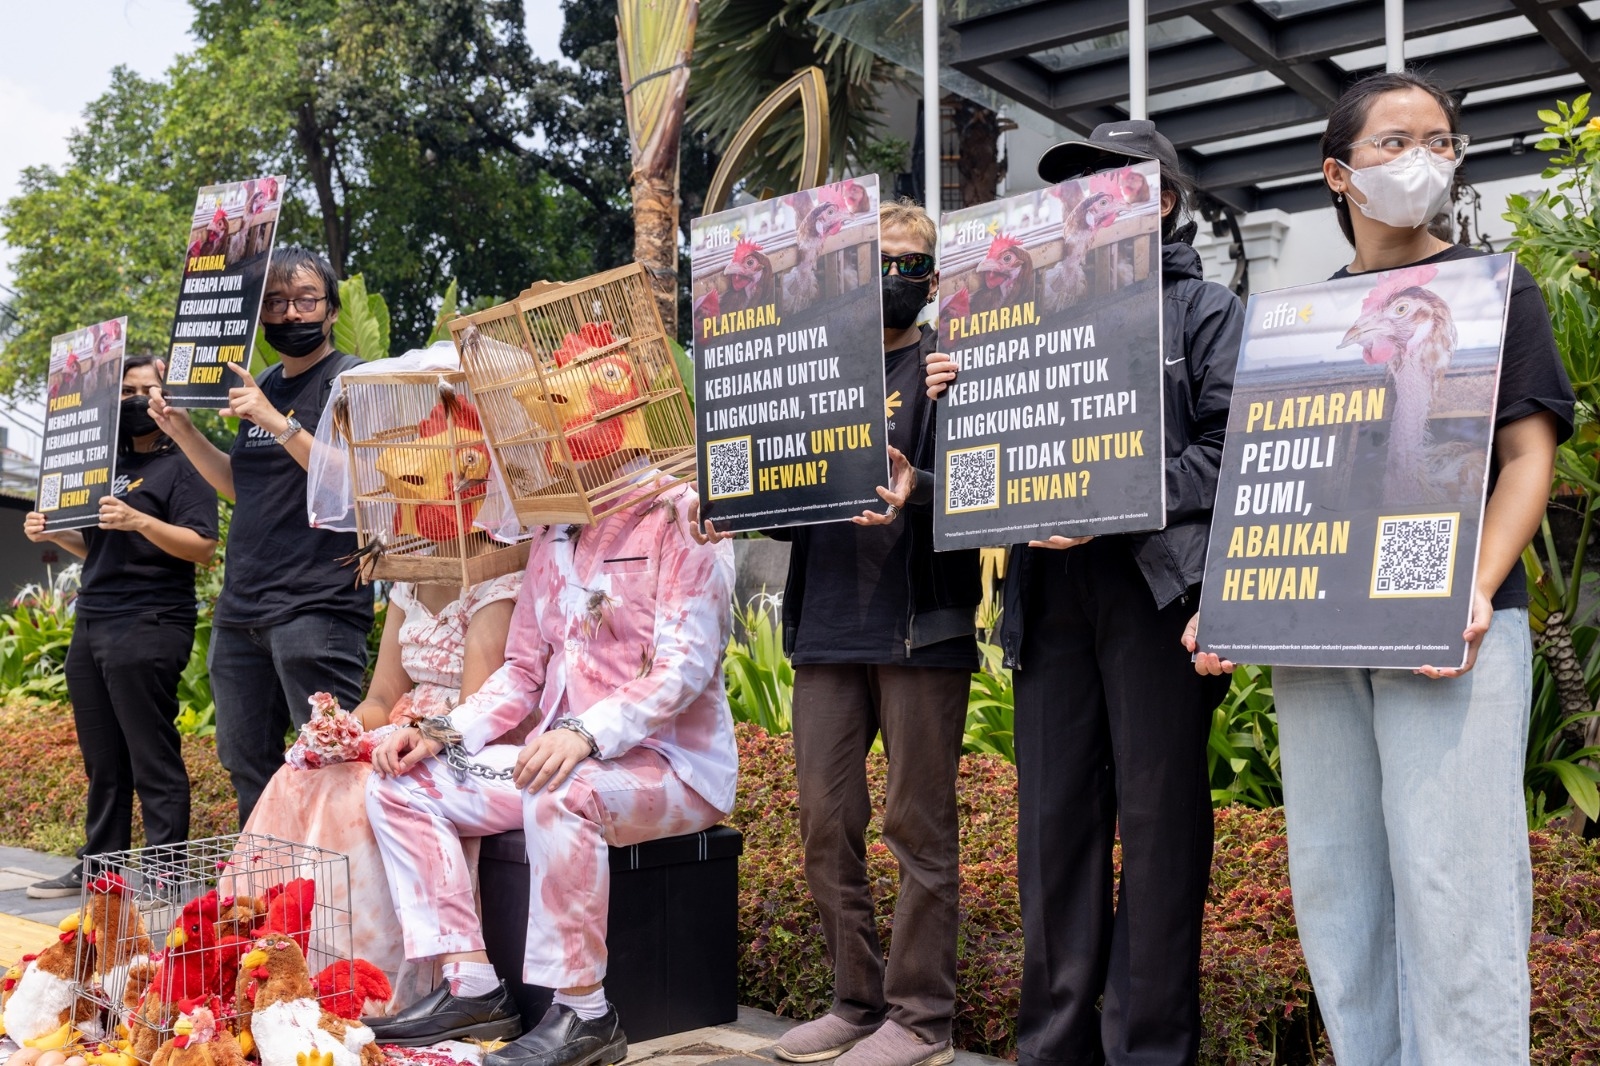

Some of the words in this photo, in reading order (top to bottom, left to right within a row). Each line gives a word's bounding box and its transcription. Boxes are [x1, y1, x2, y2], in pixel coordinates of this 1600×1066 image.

[706, 224, 730, 250] affa
[957, 219, 986, 246] affa
[188, 254, 226, 272] PLATARAN,
[183, 277, 219, 294] MENGAPA
[218, 275, 243, 292] PUNYA
[179, 299, 219, 315] KEBIJAKAN
[218, 297, 244, 314] UNTUK
[703, 303, 781, 339] PLATARAN,
[949, 301, 1041, 341] PLATARAN,
[1262, 302, 1297, 330] affa
[175, 321, 222, 338] LINGKUNGAN,
[223, 319, 248, 336] TETAPI
[194, 346, 219, 363] TIDAK
[217, 345, 246, 362] UNTUK
[704, 336, 773, 370] MENGAPA
[777, 326, 828, 356] PUNYA
[950, 337, 1030, 372] MENGAPA
[1035, 324, 1096, 357] PUNYA
[190, 366, 223, 384] HEWAN?
[705, 366, 783, 401] KEBIJAKAN
[787, 356, 840, 386] UNTUK
[948, 369, 1040, 407] KEBIJAKAN
[1045, 357, 1110, 390] UNTUK
[47, 412, 77, 431] MENGAPA
[77, 407, 99, 425] PUNYA
[49, 392, 82, 412] PLATARAN,
[706, 396, 805, 432] LINGKUNGAN,
[809, 386, 865, 415] TETAPI
[947, 401, 1066, 441] LINGKUNGAN,
[1070, 390, 1137, 422] TETAPI
[1246, 388, 1386, 433] PLATARAN
[45, 431, 79, 451] KEBIJAKAN
[79, 426, 102, 444] UNTUK
[757, 432, 808, 462] TIDAK
[811, 423, 873, 455] UNTUK
[1006, 440, 1067, 473] TIDAK
[1071, 430, 1144, 465] UNTUK
[1240, 435, 1336, 474] PEDULI
[43, 450, 85, 470] LINGKUNGAN,
[86, 445, 108, 462] TETAPI
[62, 472, 84, 490] TIDAK
[83, 467, 109, 486] UNTUK
[758, 459, 828, 492] HEWAN?
[1007, 470, 1091, 505] HEWAN?
[60, 489, 90, 508] HEWAN?
[1234, 480, 1313, 516] BUMI,
[1227, 520, 1350, 558] ABAIKAN
[1222, 566, 1326, 601] HEWAN.
